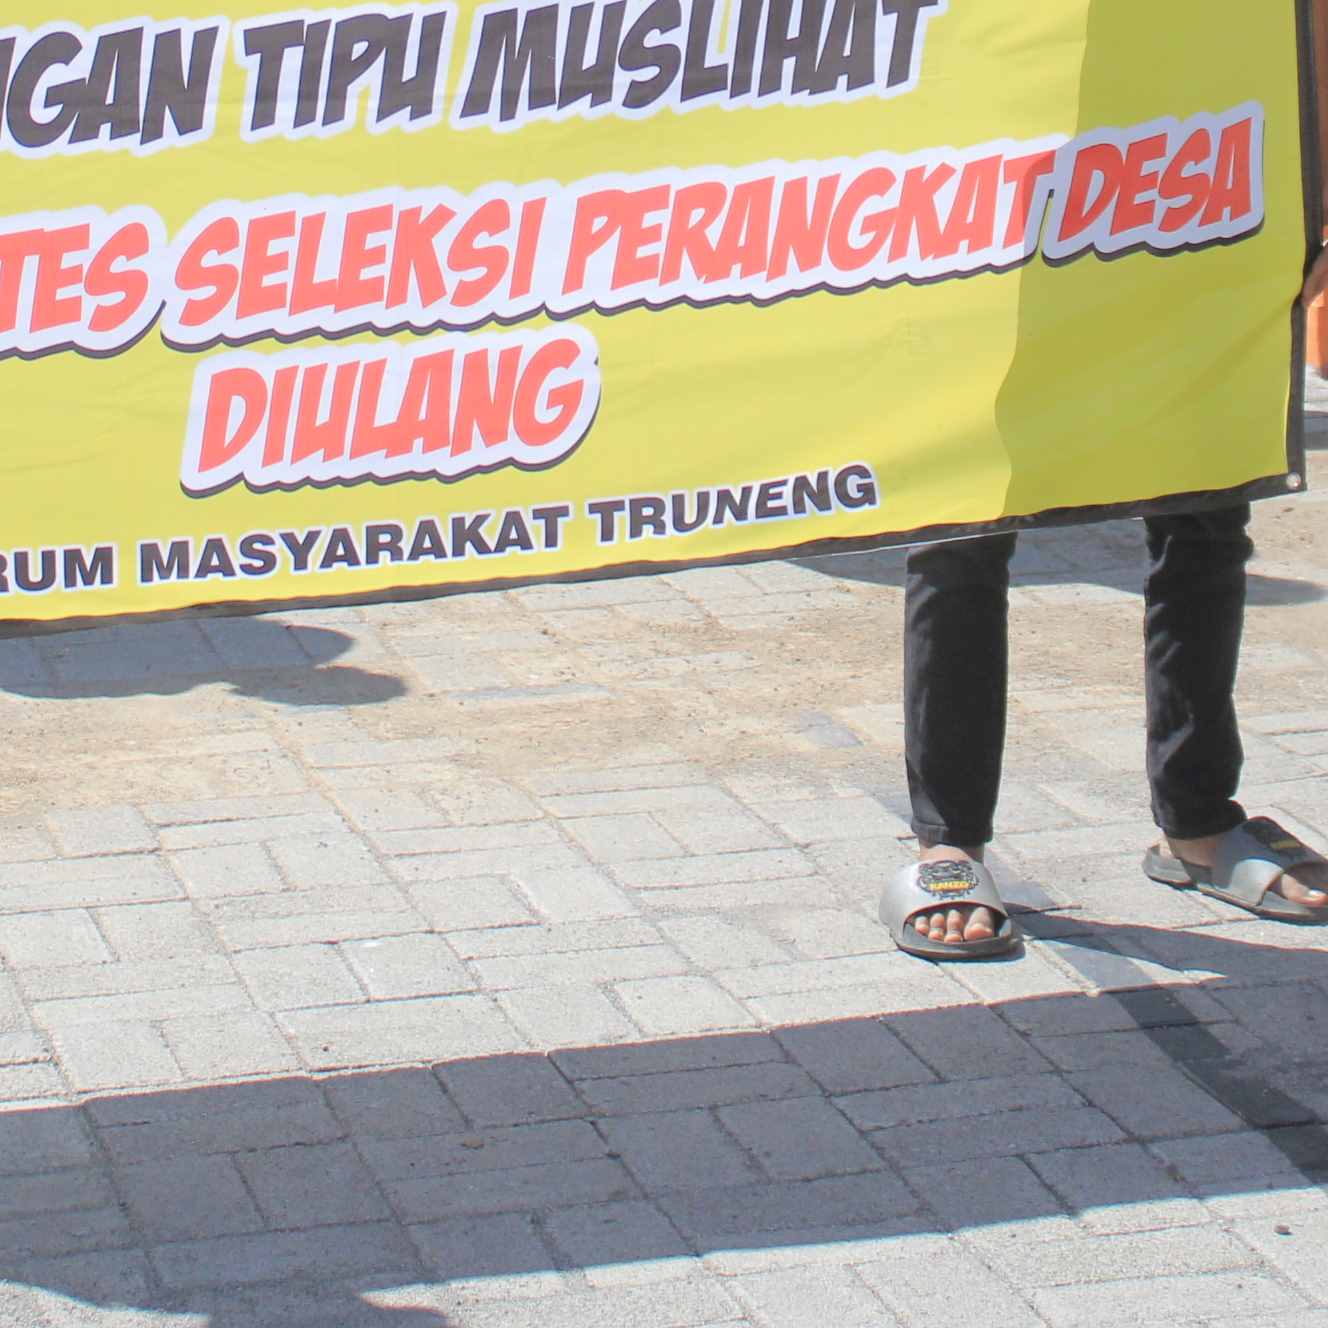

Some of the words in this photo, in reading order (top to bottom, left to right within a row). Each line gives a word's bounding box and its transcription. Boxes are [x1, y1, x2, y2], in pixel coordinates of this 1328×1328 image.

[244, 10, 447, 132] TIPU
[175, 197, 547, 328] SELEKSI
[562, 149, 1058, 295] PERANGKAT
[1059, 118, 1253, 243] DESA
[197, 337, 585, 473] DIULANG
[139, 504, 570, 584] MASYARAKAT
[600, 464, 877, 542] TRUNENG
